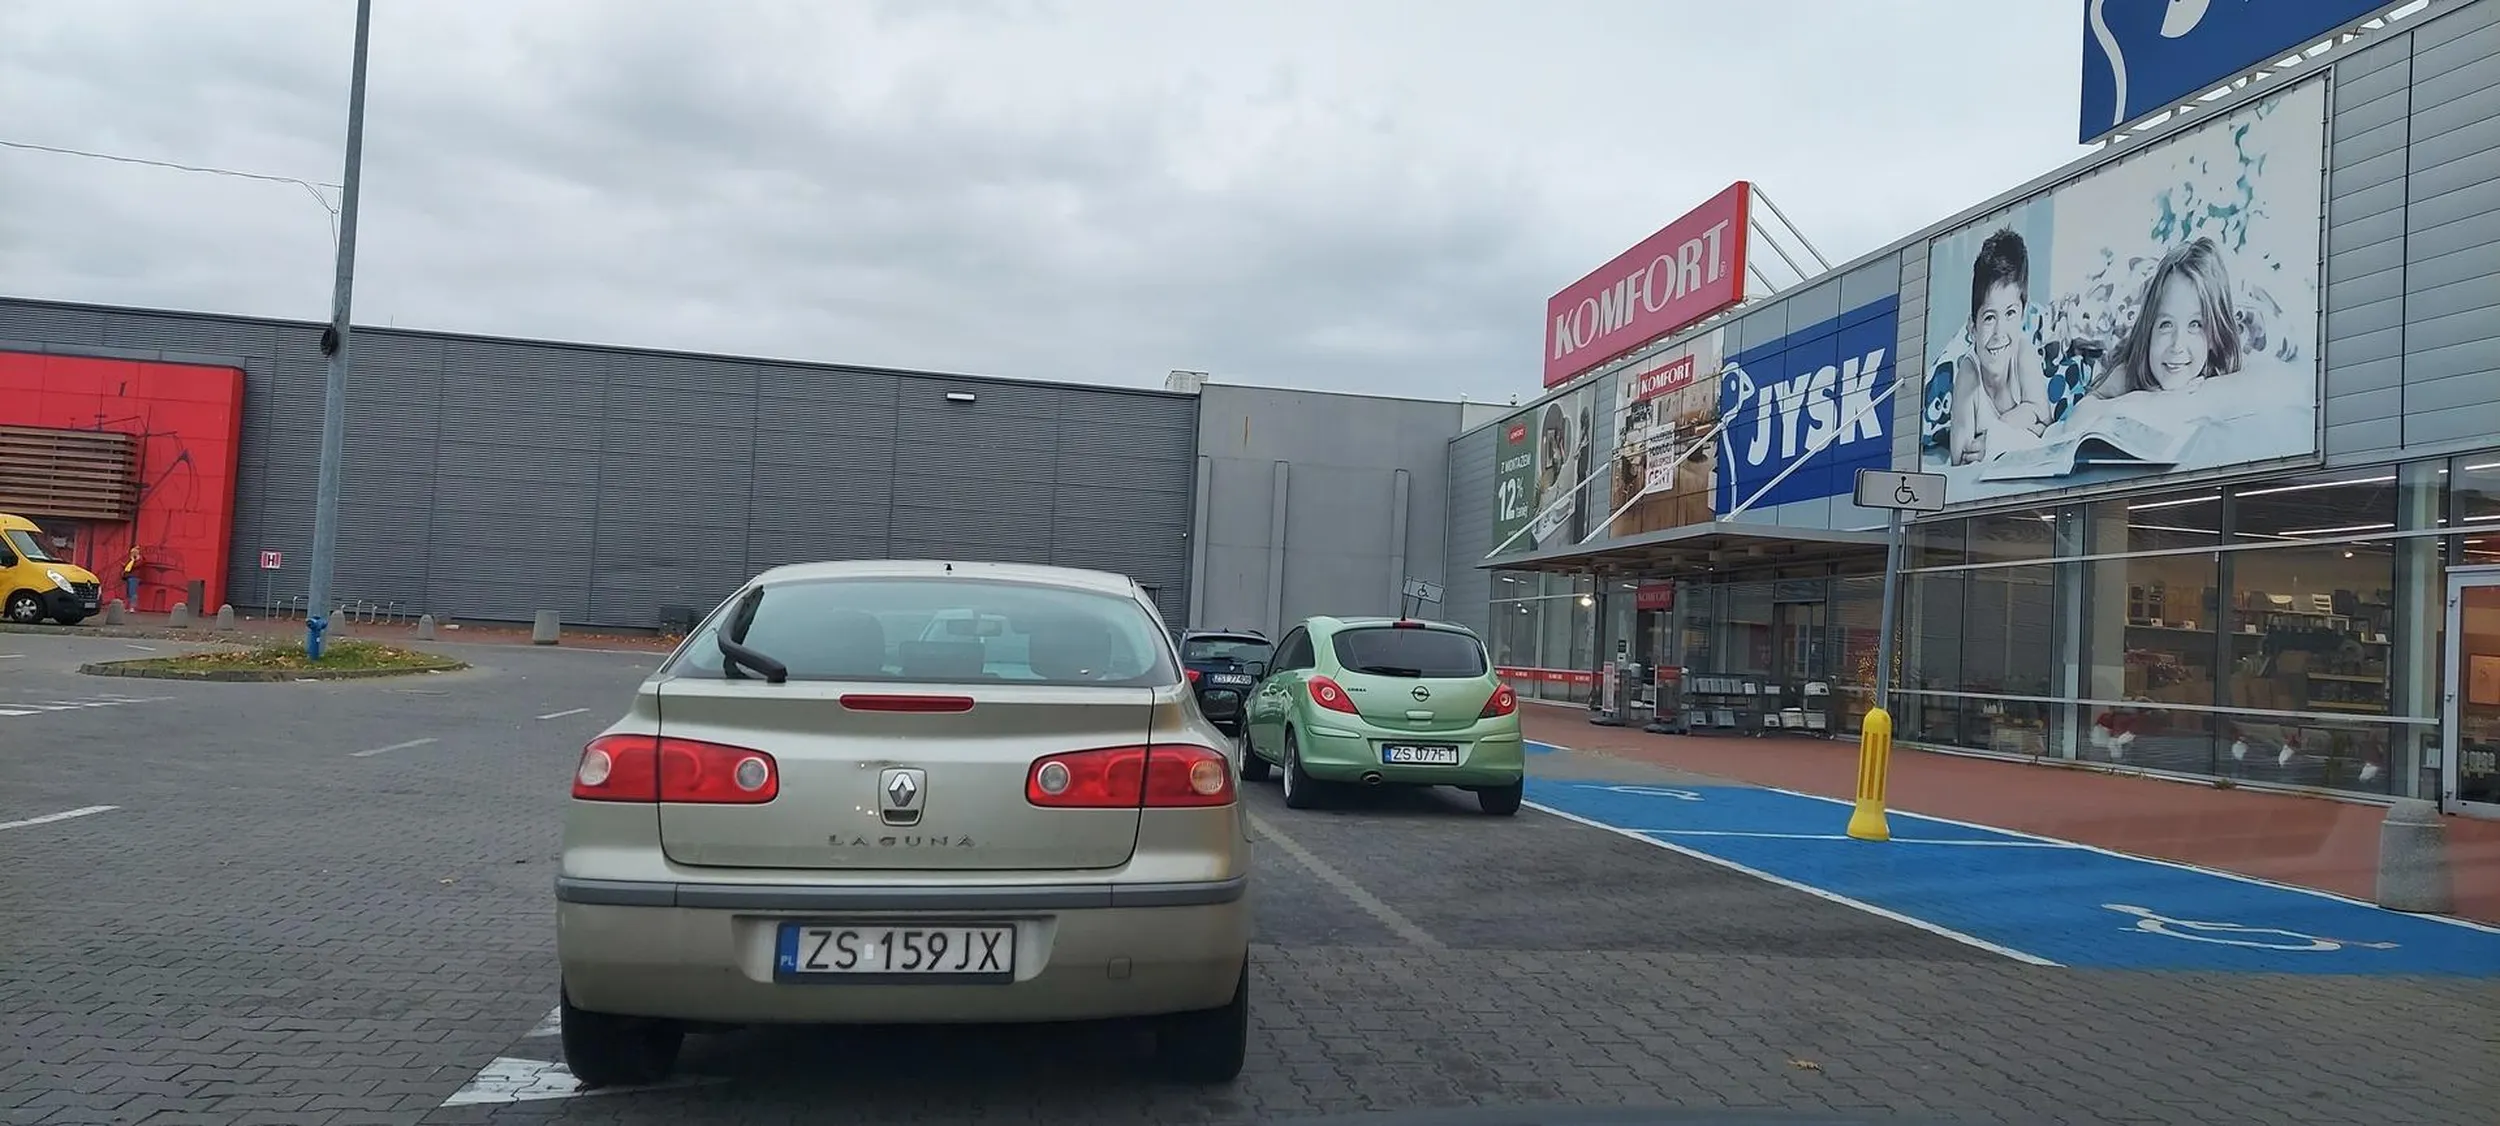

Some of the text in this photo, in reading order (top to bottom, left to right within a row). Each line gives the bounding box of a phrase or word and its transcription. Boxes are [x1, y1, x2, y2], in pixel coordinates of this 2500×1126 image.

[1554, 219, 1729, 360] KOMFORT
[1641, 362, 1691, 394] KOMFORT
[1747, 348, 1886, 466] JYSK
[267, 554, 275, 566] H
[1393, 747, 1412, 761] ZS
[828, 834, 977, 847] LAGUNA
[780, 955, 795, 966] PL
[805, 931, 1003, 971] ZS 159JX
